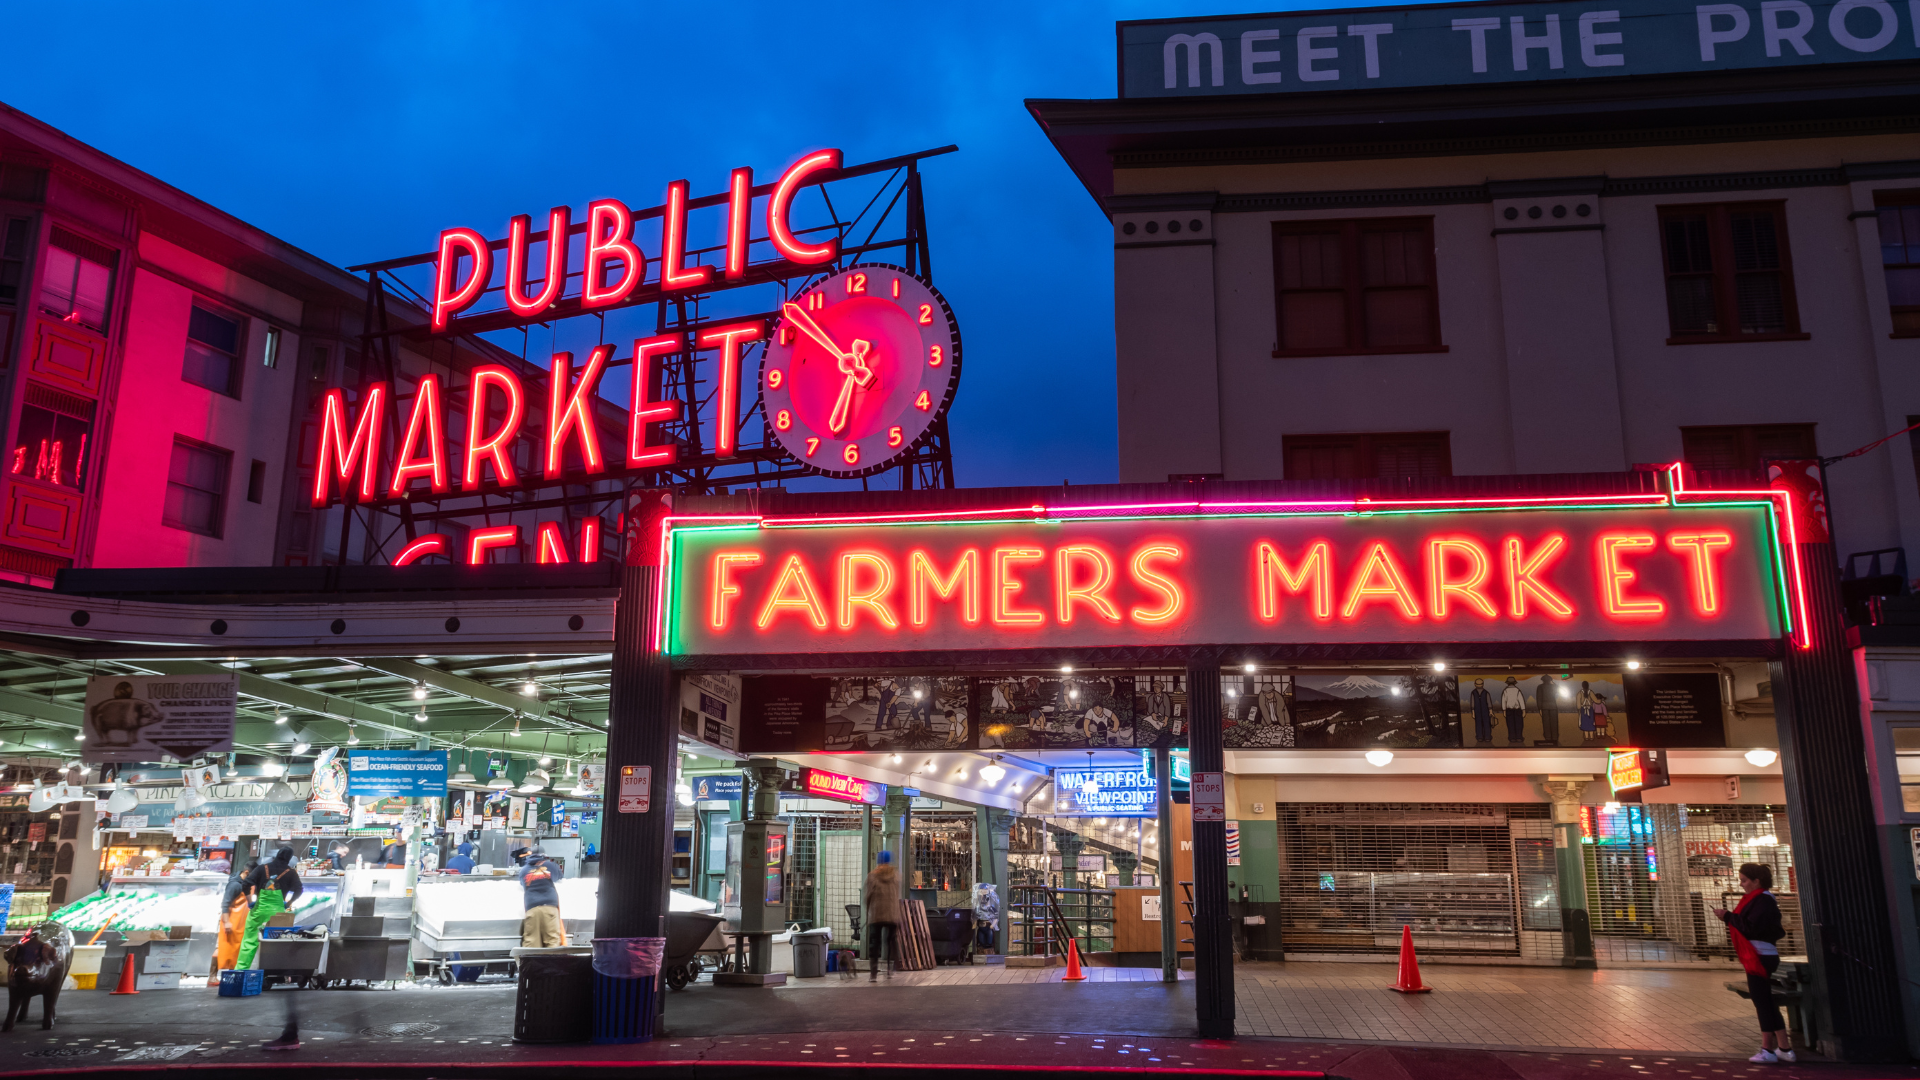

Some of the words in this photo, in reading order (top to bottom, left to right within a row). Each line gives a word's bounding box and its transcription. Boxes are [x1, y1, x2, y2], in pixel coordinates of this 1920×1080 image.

[1164, 23, 1393, 89] MEET
[1451, 11, 1625, 73] THE
[431, 148, 843, 334] PUBLIC
[846, 273, 867, 295] 12
[892, 278, 900, 299] 1
[809, 290, 824, 311] 11
[919, 304, 933, 325] 2
[928, 345, 943, 367] 3
[768, 369, 783, 389] 9
[915, 390, 932, 411] 4
[311, 320, 768, 509] MARKET
[776, 409, 791, 431] 8
[805, 437, 821, 457] 7
[888, 426, 902, 448] 5
[843, 444, 860, 464] 6
[711, 542, 1183, 629] FARMERS
[1257, 533, 1732, 620] MARKET
[148, 683, 181, 699] YOUR
[183, 682, 235, 699] CHANGE
[370, 763, 416, 771] OCEAN-FRIENDLY
[416, 763, 443, 771] SEAFOOD
[1612, 768, 1642, 787] GROCERY
[624, 777, 647, 785] STOPS
[1060, 771, 1158, 789] WATERFRO
[1196, 784, 1220, 792] STOPS
[1075, 790, 1157, 805] VIEWPOINT
[234, 804, 255, 816] fresh
[268, 803, 292, 815] hours
